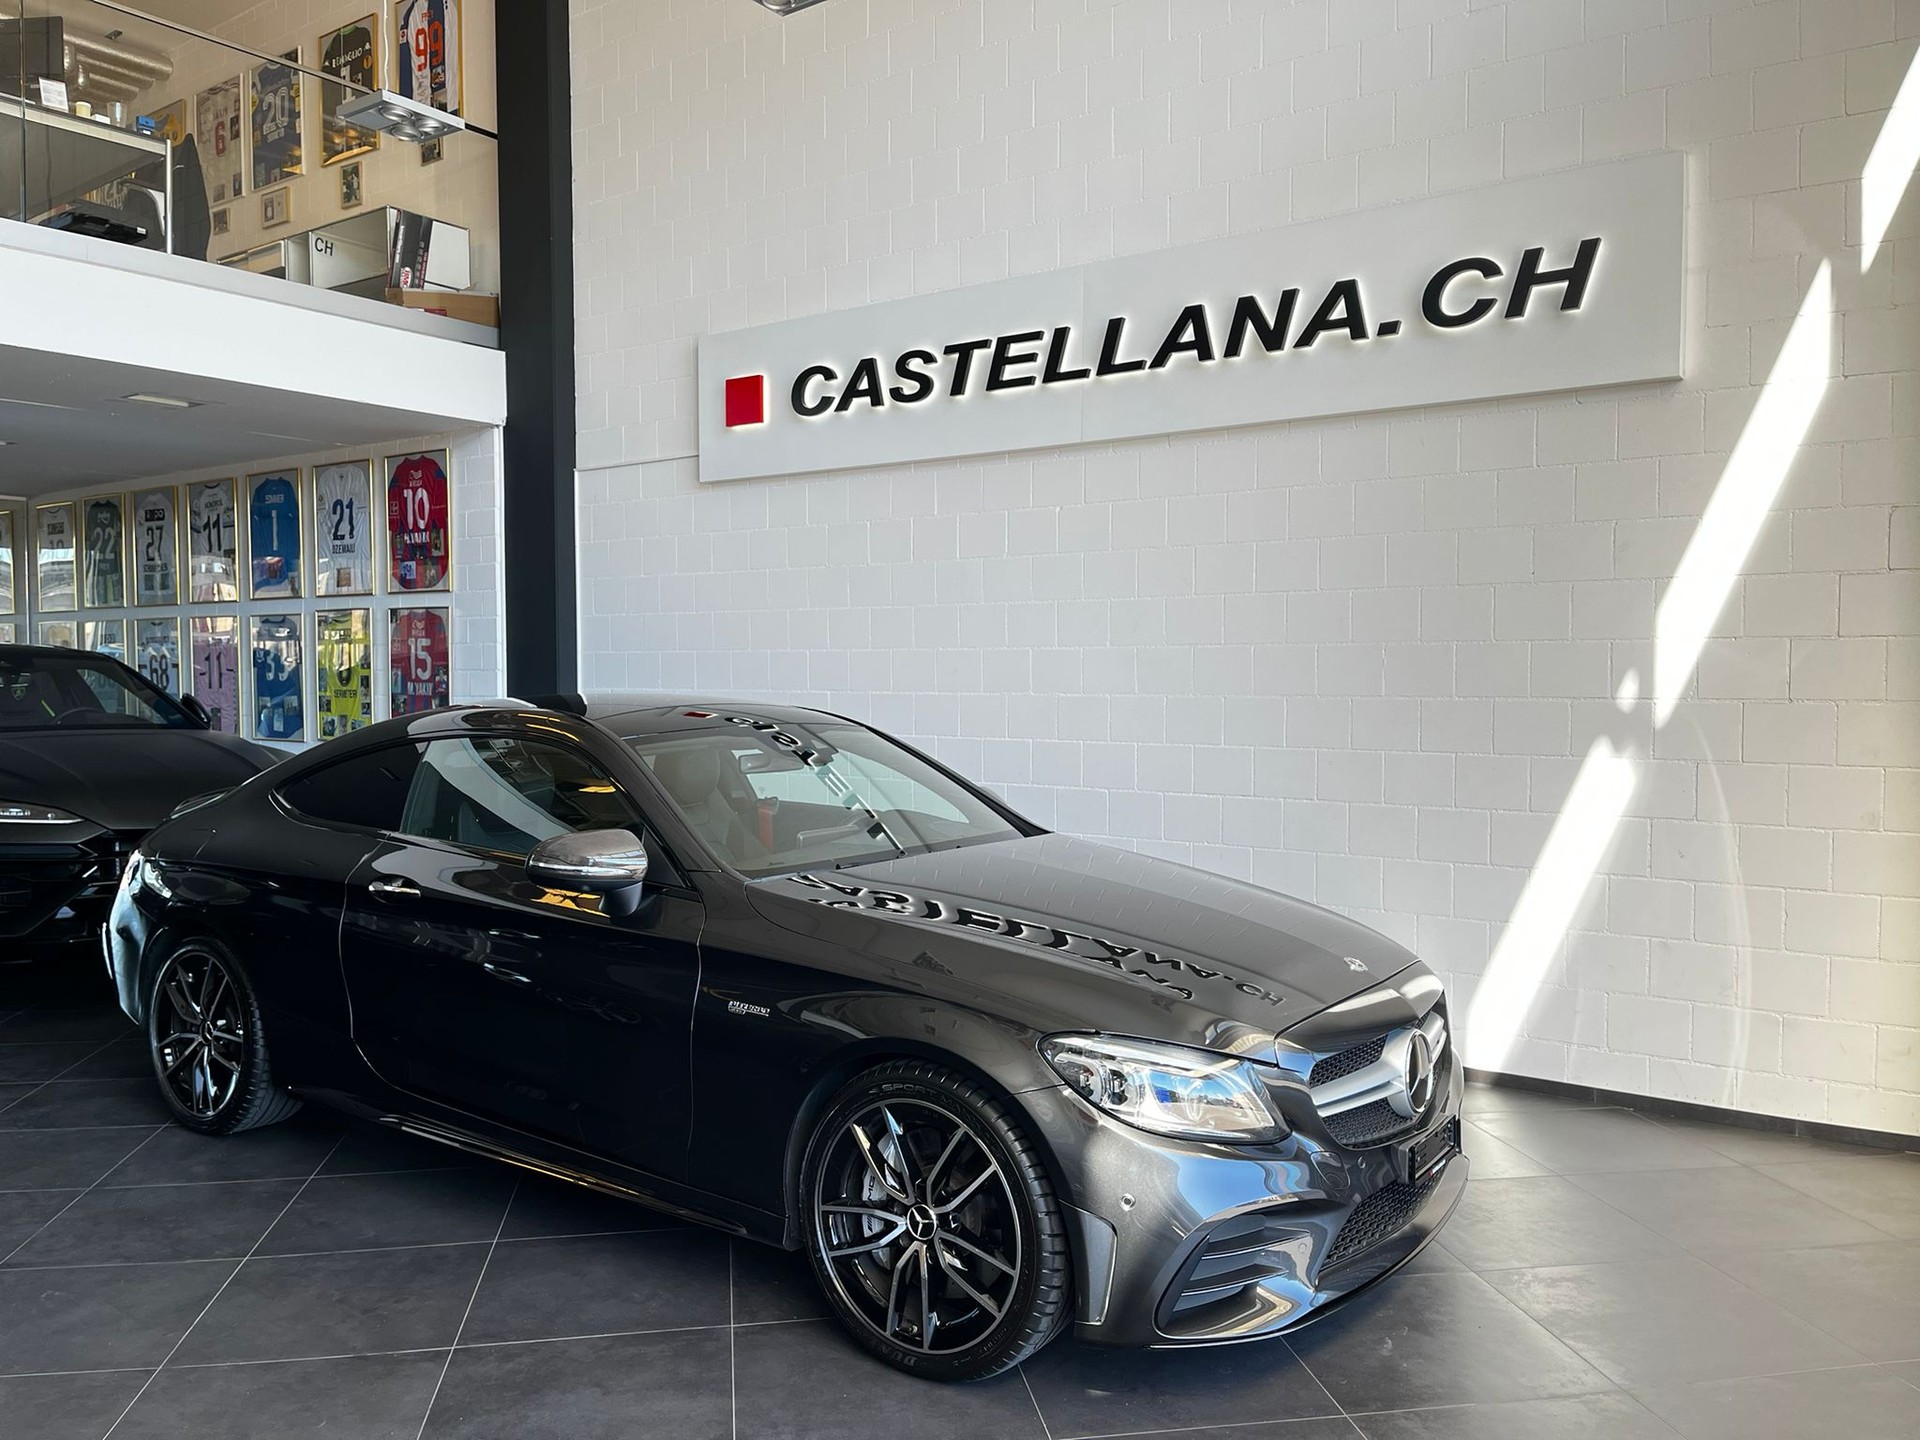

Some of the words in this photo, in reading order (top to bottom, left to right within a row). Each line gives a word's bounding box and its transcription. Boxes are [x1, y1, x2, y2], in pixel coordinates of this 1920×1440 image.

[415, 20, 443, 73] 99
[262, 86, 288, 135] 20
[314, 236, 334, 257] CH
[790, 237, 1601, 416] CASTELLANA.CH
[332, 497, 355, 541] 21
[404, 487, 430, 530] 10
[93, 527, 115, 560] 22
[145, 525, 164, 562] 27
[202, 513, 222, 553] 11
[271, 509, 278, 551] 1
[204, 651, 223, 690] 11
[408, 637, 432, 681] 15
[881, 1083, 937, 1096] SPORT
[867, 1175, 876, 1201] MG
